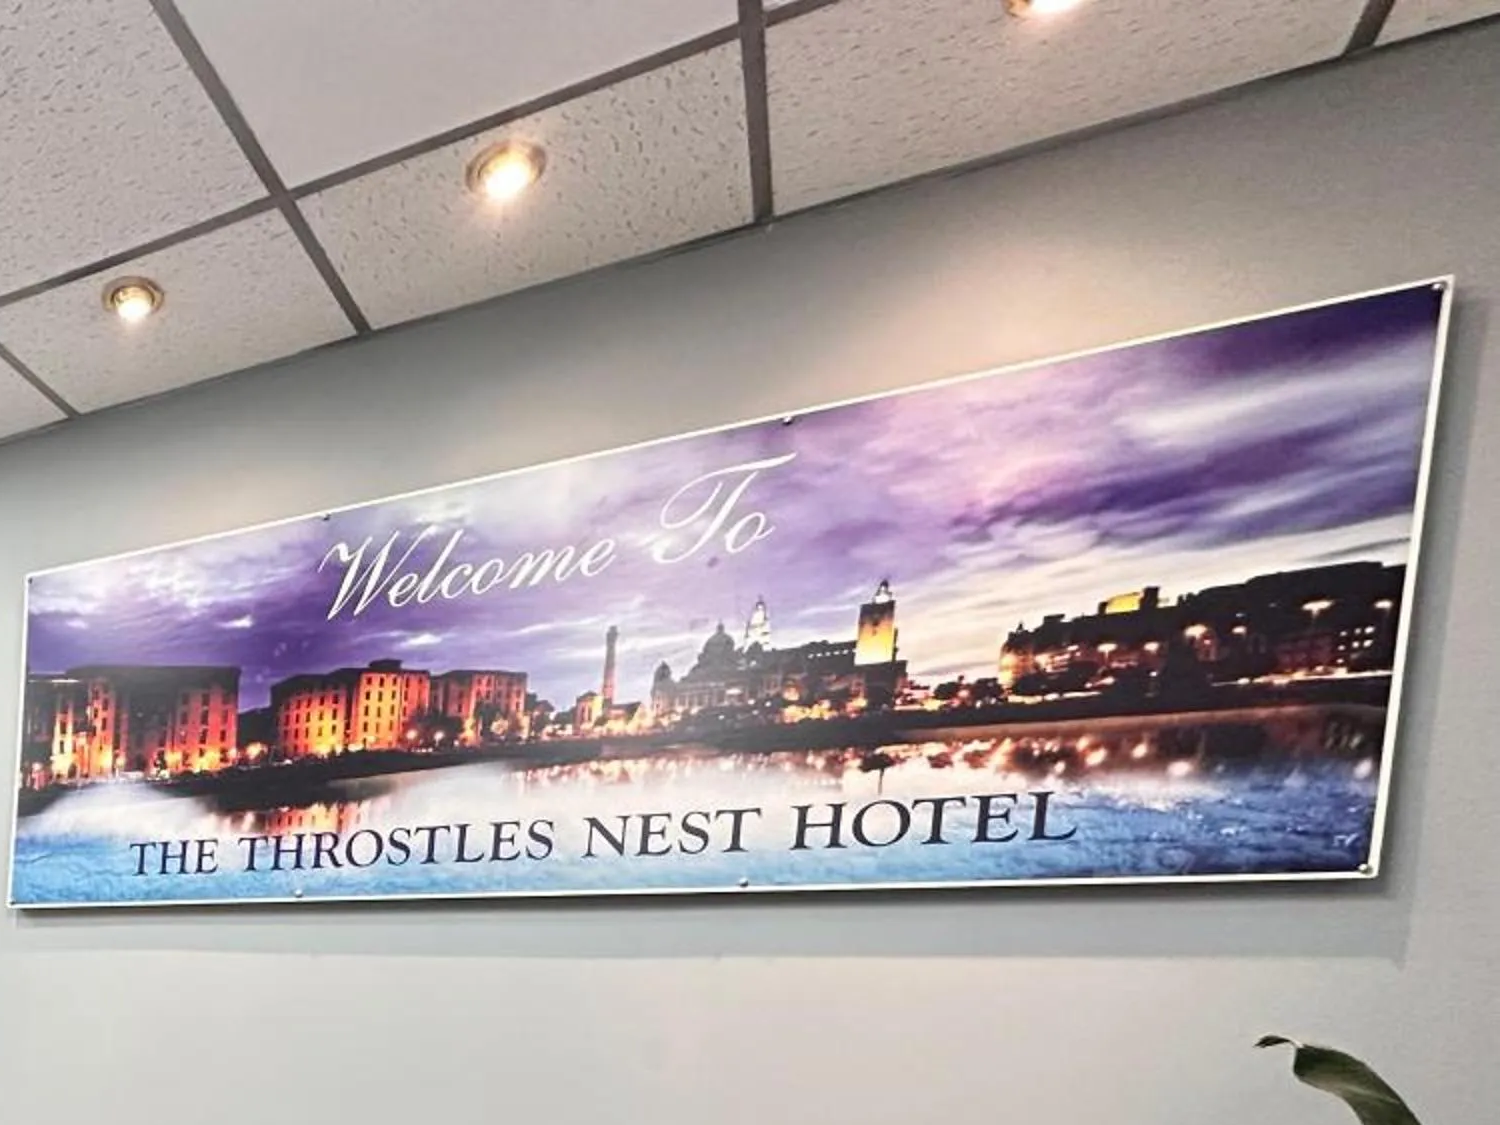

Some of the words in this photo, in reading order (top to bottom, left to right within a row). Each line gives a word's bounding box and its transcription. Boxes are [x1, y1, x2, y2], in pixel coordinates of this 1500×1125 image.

[318, 523, 616, 620] Welcome
[652, 452, 796, 563] To
[130, 839, 219, 876] THE
[238, 819, 554, 872] THROSTLES
[581, 808, 761, 857] NEST
[790, 792, 1077, 850] HOTEL
